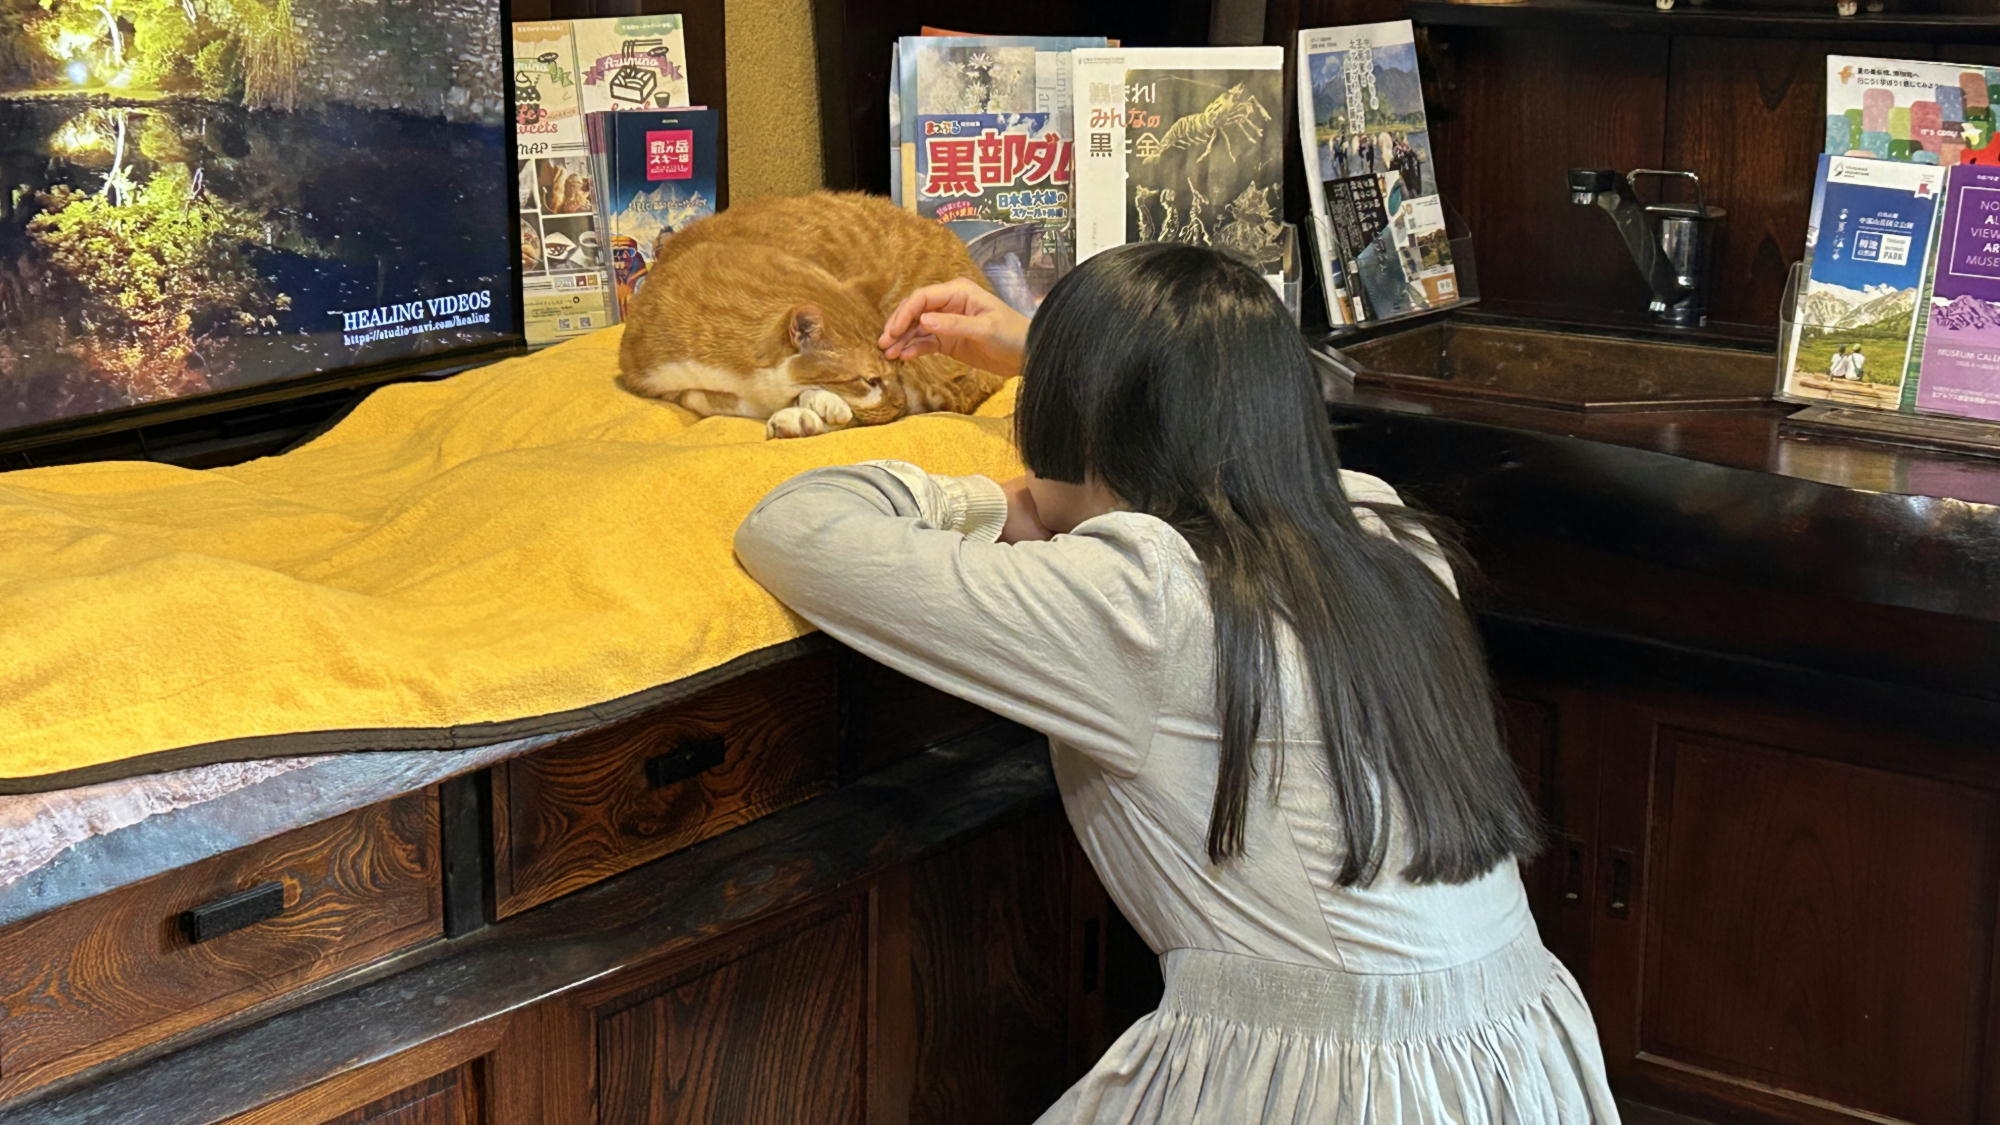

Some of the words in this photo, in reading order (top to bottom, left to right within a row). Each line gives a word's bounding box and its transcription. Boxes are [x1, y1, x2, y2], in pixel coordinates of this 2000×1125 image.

[1090, 108, 1161, 128] みんなの
[996, 189, 1068, 210] 日本最大級の
[1883, 251, 1904, 261] PARK
[343, 301, 424, 332] HEALING
[426, 290, 492, 317] VIDEOS
[344, 313, 491, 346] https://studio-navi.com/healing
[1937, 348, 1975, 359] MUSEUM
